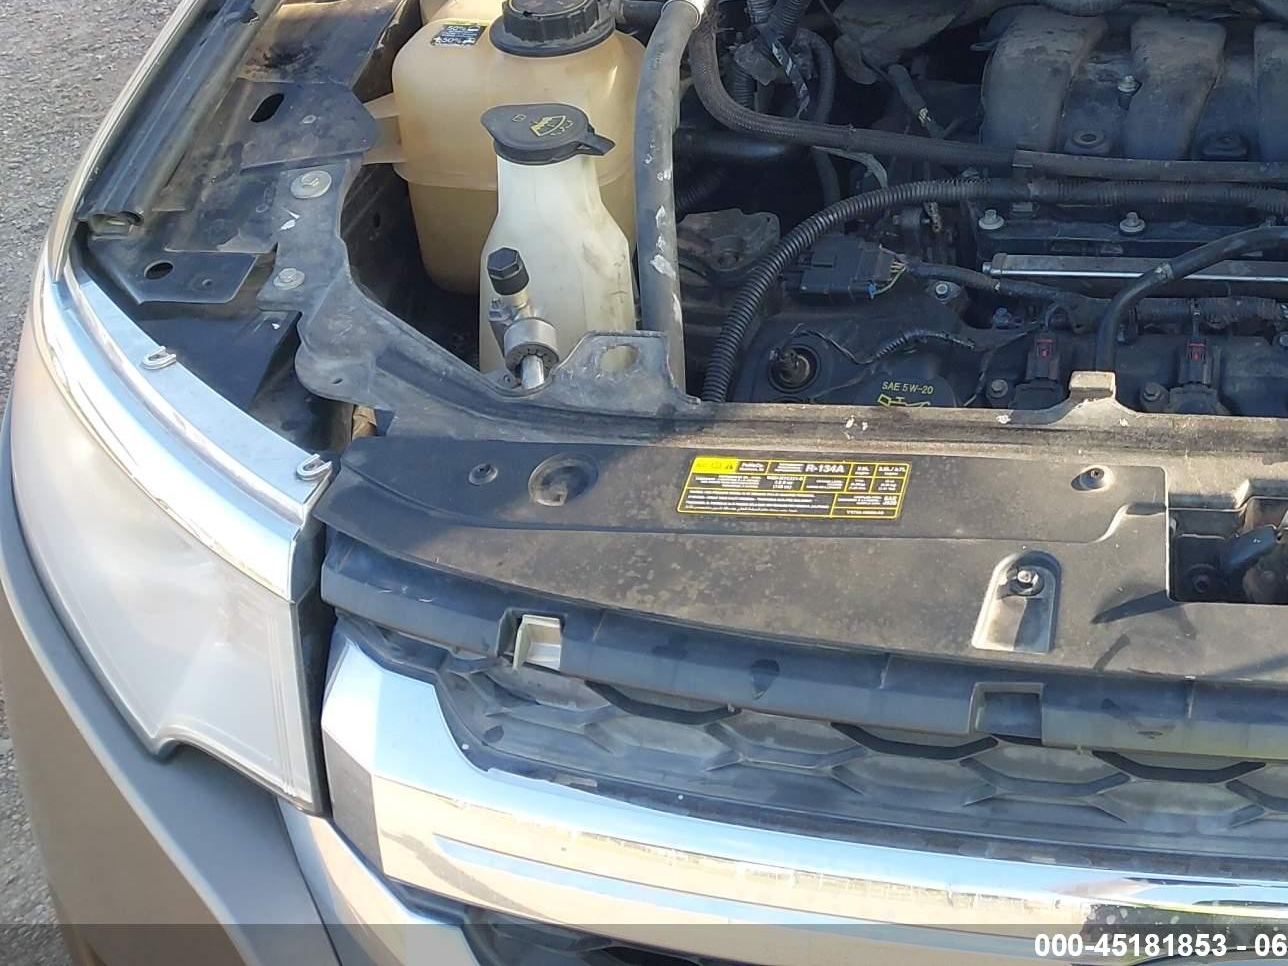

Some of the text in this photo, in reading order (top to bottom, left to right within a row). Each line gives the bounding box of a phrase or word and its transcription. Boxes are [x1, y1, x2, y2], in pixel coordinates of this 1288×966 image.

[881, 381, 934, 395] SAE 5W-20
[805, 464, 845, 473] R-134A
